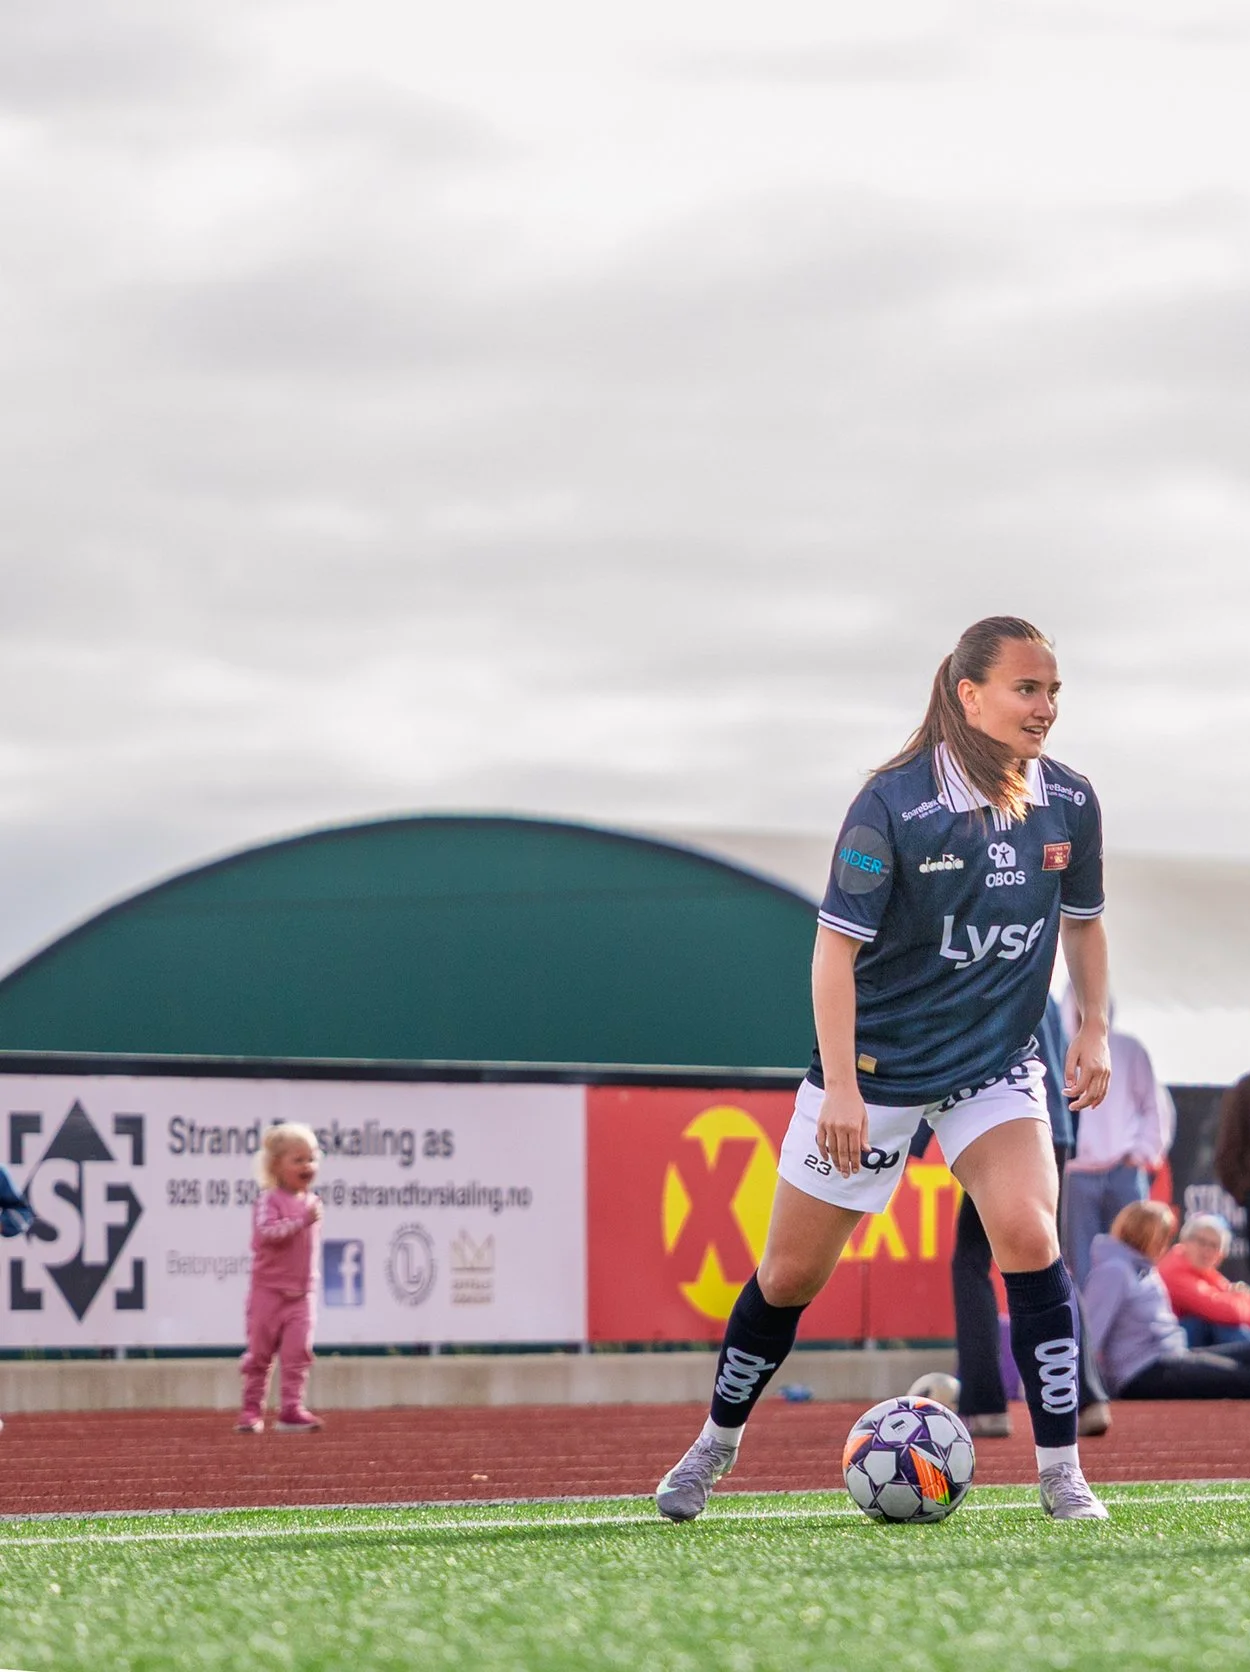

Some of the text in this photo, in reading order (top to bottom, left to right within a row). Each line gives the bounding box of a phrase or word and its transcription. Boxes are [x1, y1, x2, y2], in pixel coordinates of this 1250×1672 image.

[1045, 783, 1074, 797] reBank
[839, 847, 882, 875] AIDER
[919, 853, 964, 873] diadora
[985, 870, 1026, 888] OBOS
[939, 915, 1045, 969] Lyse
[168, 1115, 454, 1167] Strand skaling as
[804, 1154, 832, 1176] 23
[28, 1157, 130, 1266] SF
